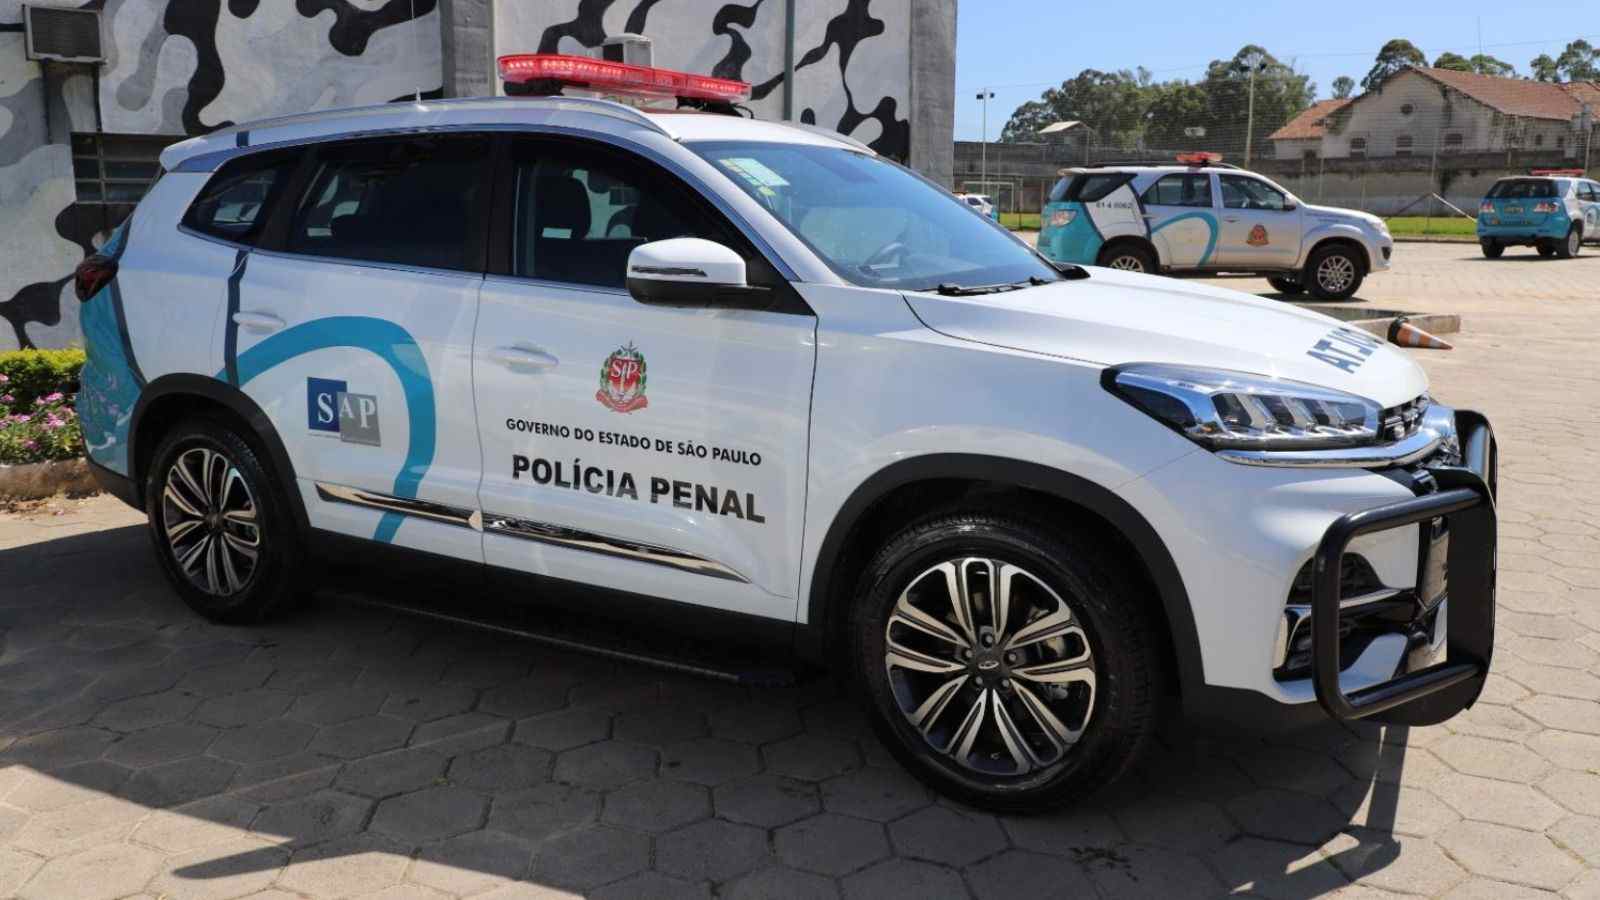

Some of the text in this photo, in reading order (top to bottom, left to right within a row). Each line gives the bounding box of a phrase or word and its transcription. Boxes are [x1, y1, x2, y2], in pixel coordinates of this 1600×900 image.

[318, 392, 376, 428] SAP
[506, 418, 762, 467] GOVERNO DO ESTADO DE SÃO PAULO
[512, 454, 766, 524] POLÍCIA PENAL
